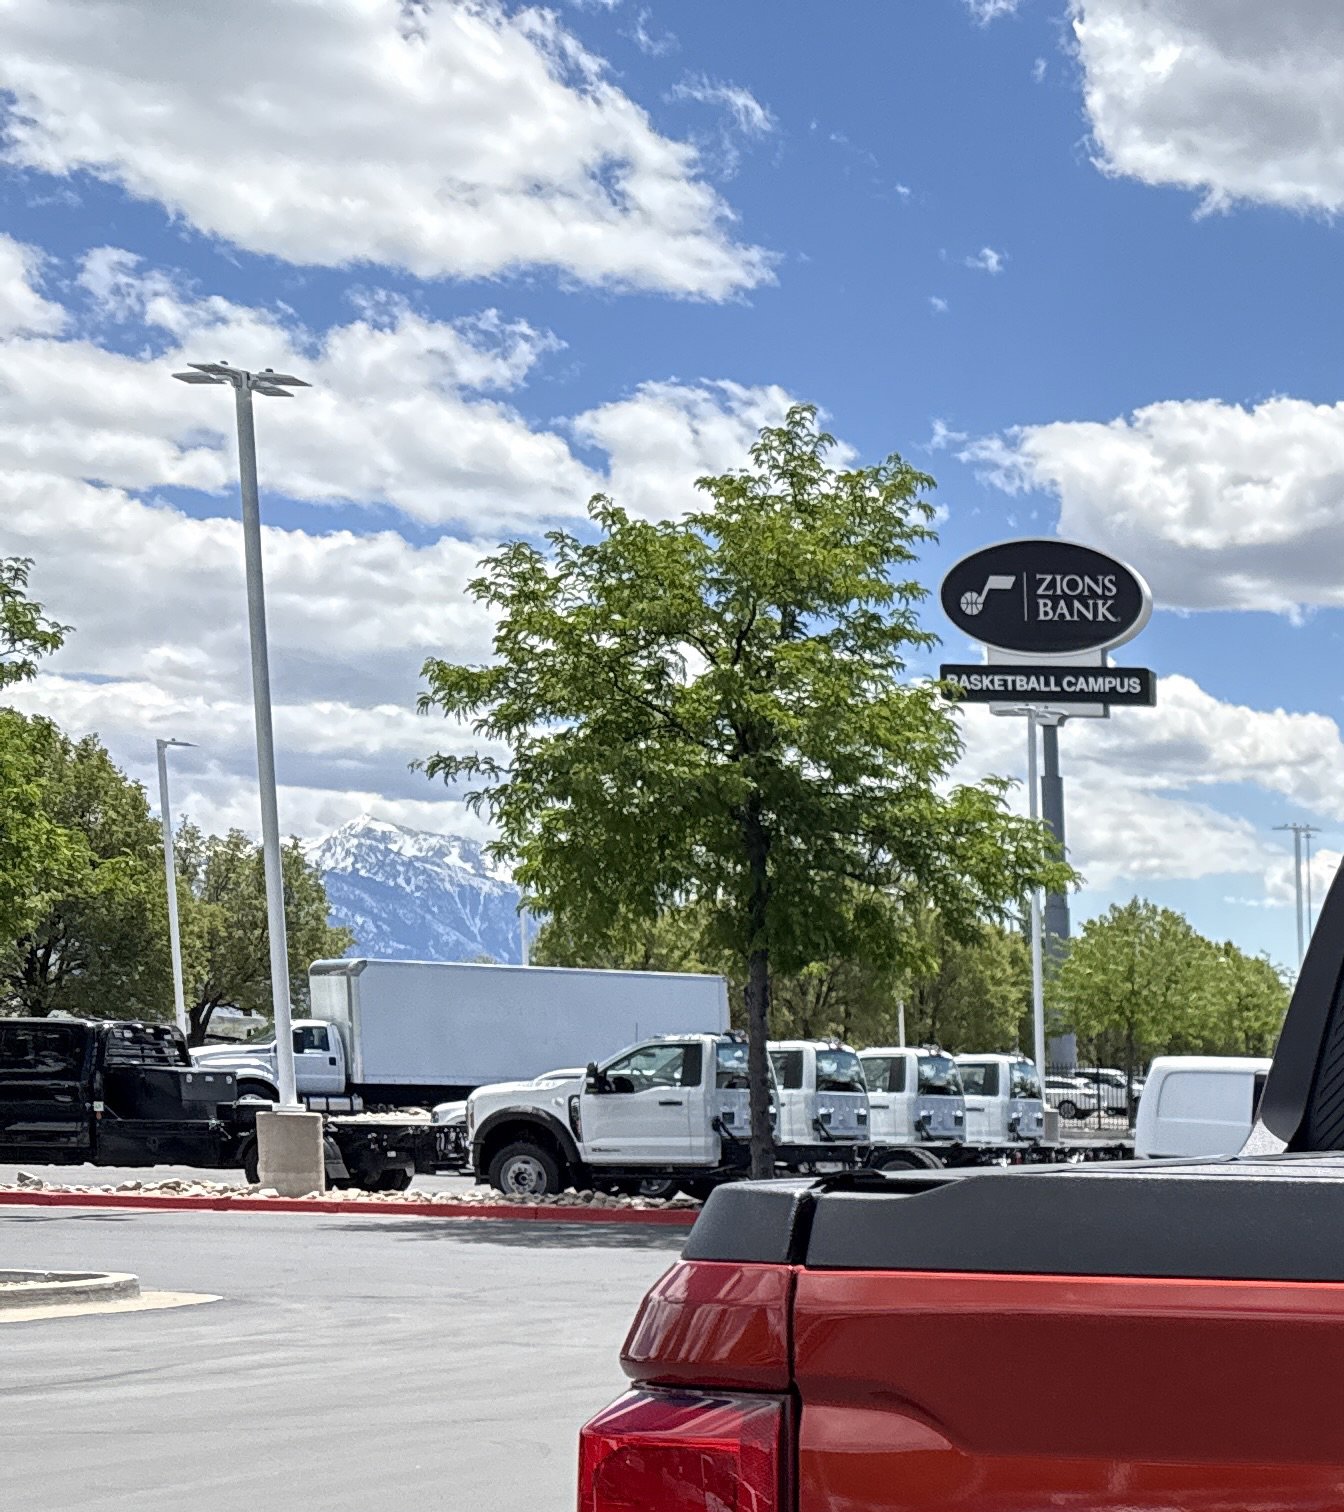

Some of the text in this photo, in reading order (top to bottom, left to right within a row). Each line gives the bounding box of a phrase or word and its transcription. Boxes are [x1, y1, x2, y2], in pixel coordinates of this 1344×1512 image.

[1036, 574, 1117, 596] ZIONS
[946, 674, 1142, 694] BASKETBALL CAMPUS
